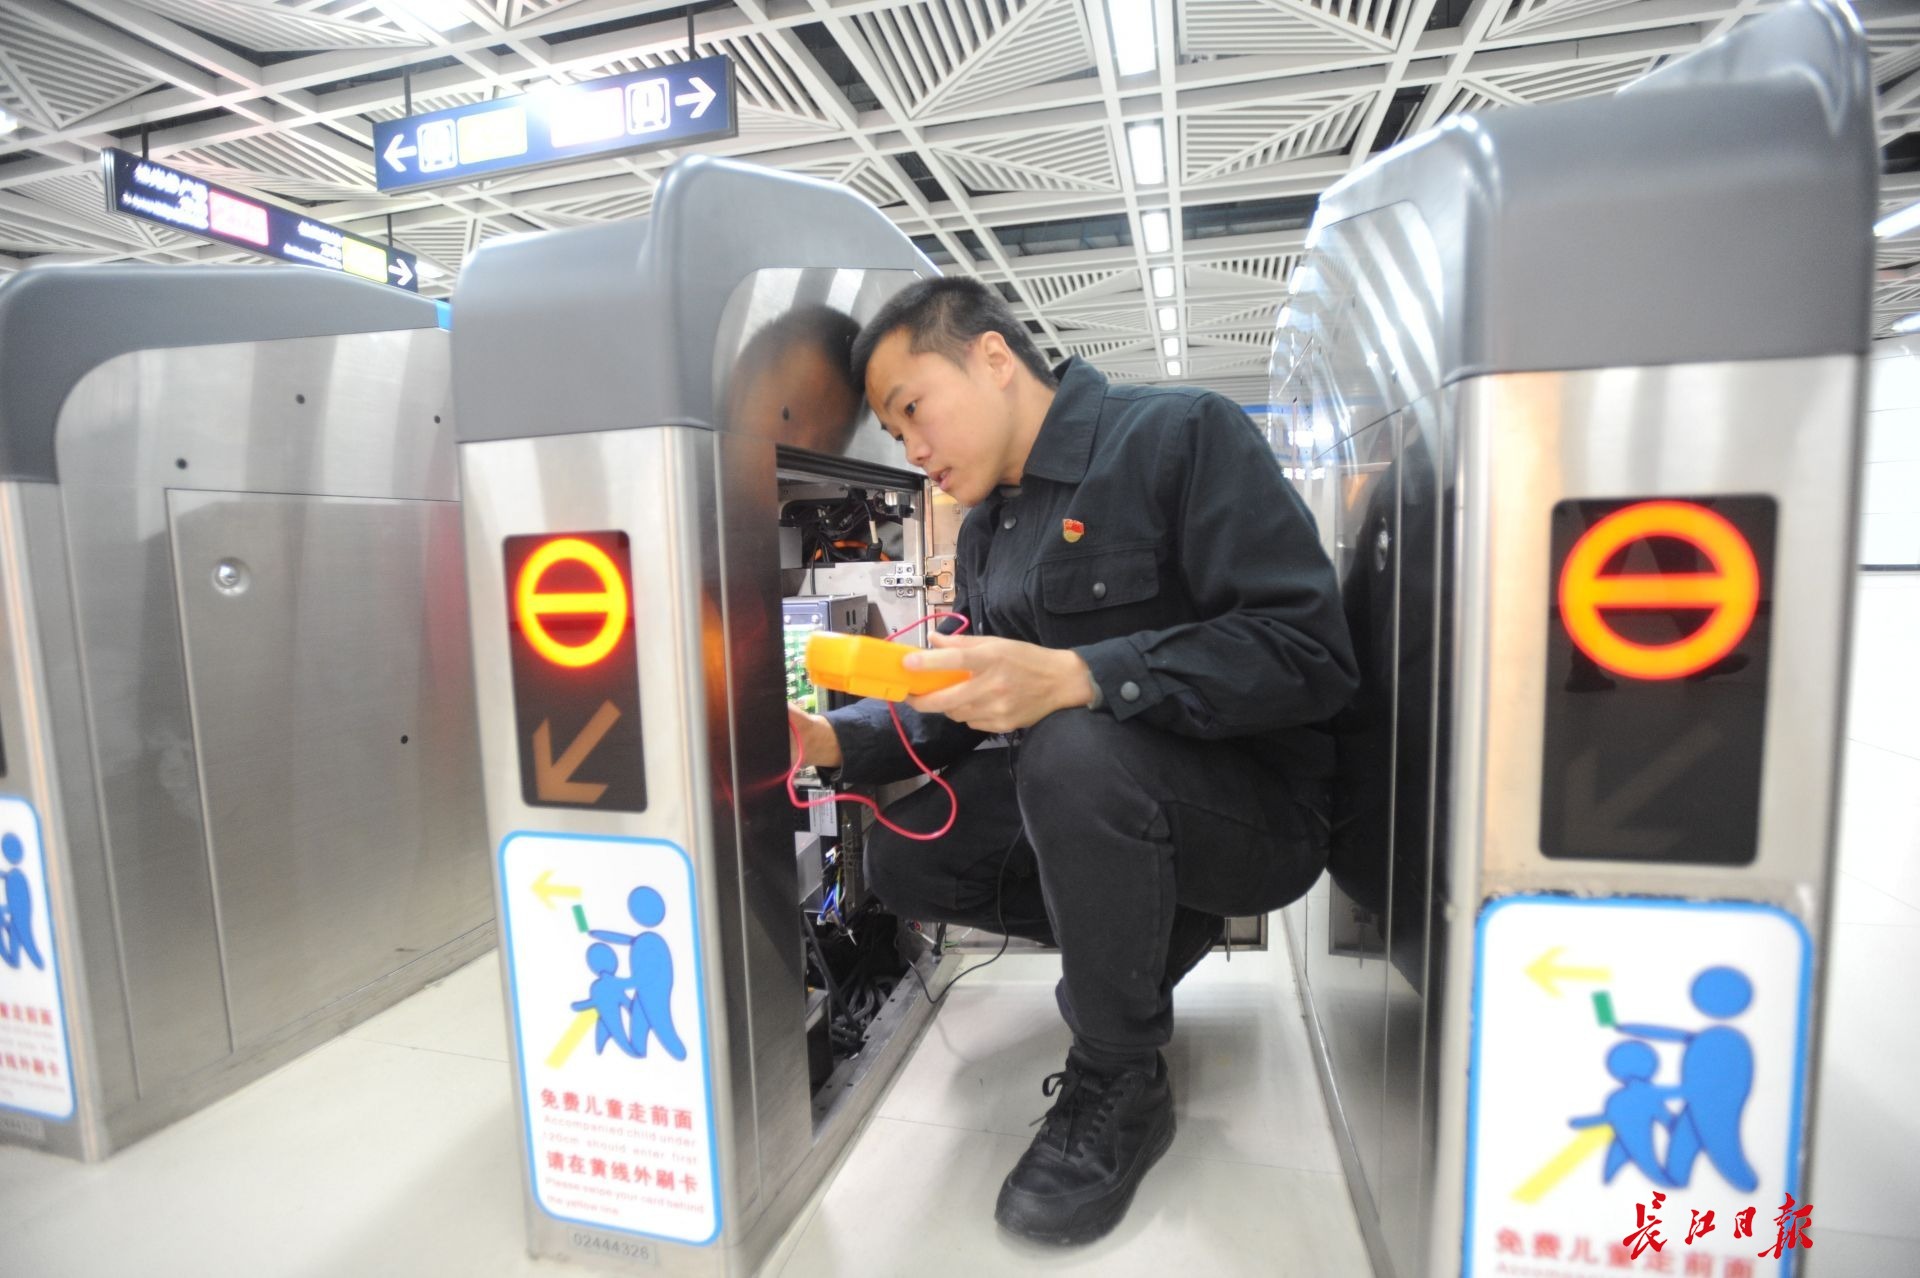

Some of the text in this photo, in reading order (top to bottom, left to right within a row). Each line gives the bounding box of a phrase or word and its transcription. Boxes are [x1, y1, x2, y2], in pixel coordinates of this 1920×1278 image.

[541, 1088, 693, 1130] 免费儿童走前面
[543, 1115, 696, 1148] Accompanied child under
[586, 1138, 626, 1153] should
[633, 1147, 665, 1160] enter
[672, 1150, 697, 1165] first
[546, 1150, 698, 1194] 请在黄线外刷卡
